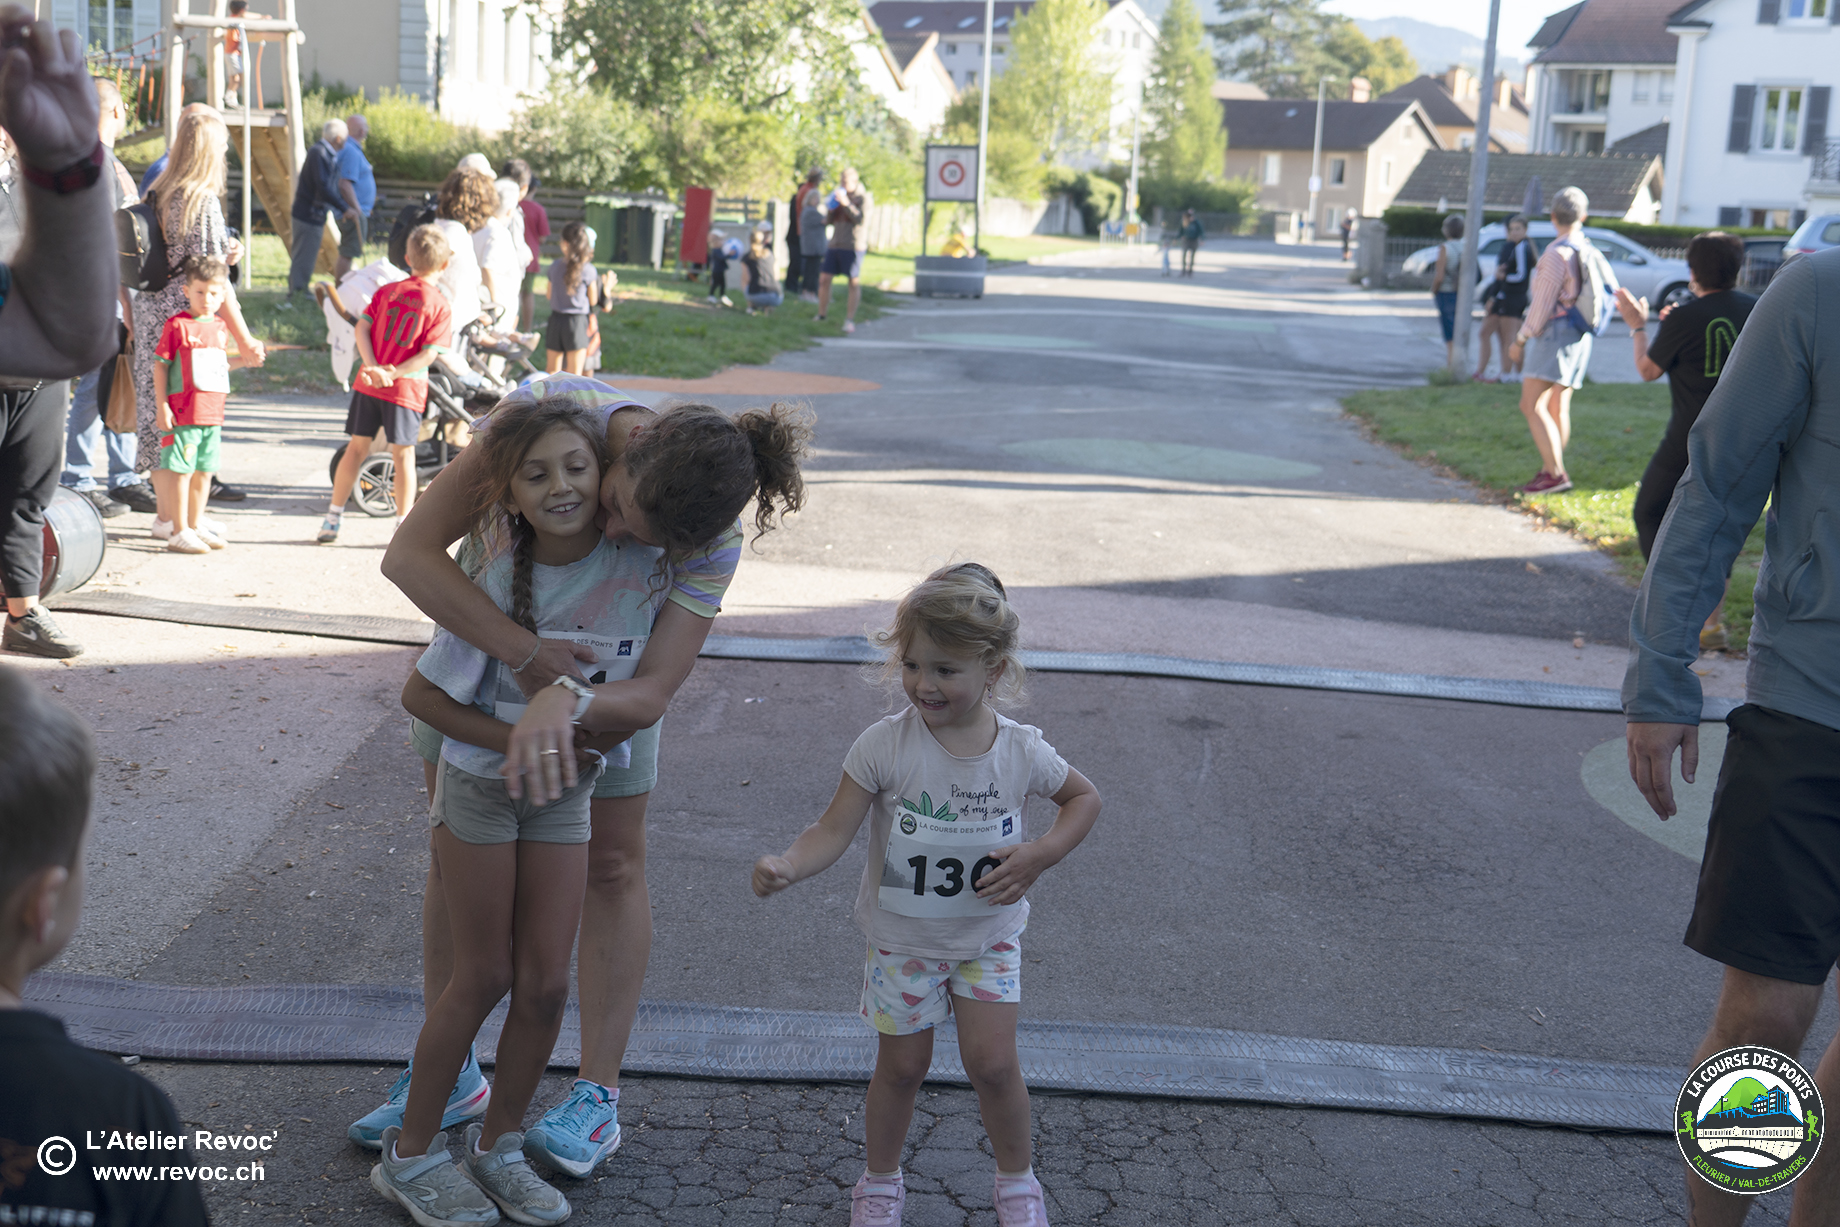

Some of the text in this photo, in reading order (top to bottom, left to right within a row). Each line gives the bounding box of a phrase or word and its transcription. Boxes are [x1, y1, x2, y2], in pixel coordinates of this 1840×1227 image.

[388, 290, 427, 310] BRAHI
[384, 306, 420, 347] 10
[590, 639, 614, 649] PONTS
[951, 782, 1000, 804] Pineapple
[960, 804, 970, 816] of
[972, 806, 988, 821] my
[919, 821, 928, 830] LA
[930, 824, 958, 834] COURSE
[976, 824, 998, 833] PONTS
